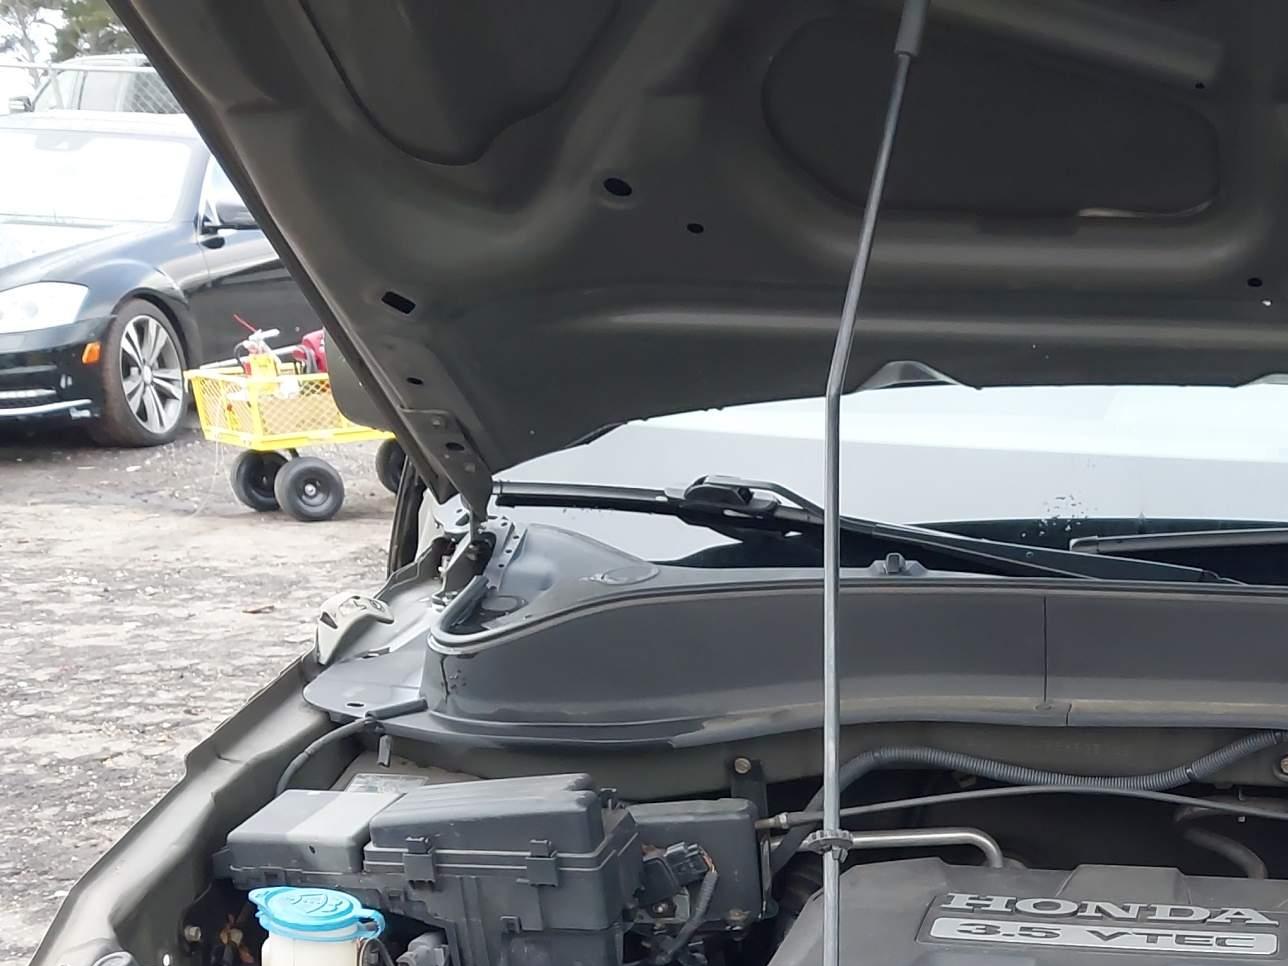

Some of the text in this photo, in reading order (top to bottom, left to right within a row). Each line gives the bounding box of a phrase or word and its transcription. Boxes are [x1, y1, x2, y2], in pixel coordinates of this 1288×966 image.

[942, 893, 1280, 927] HONDA
[956, 922, 1257, 949] 3.5 VTEC
